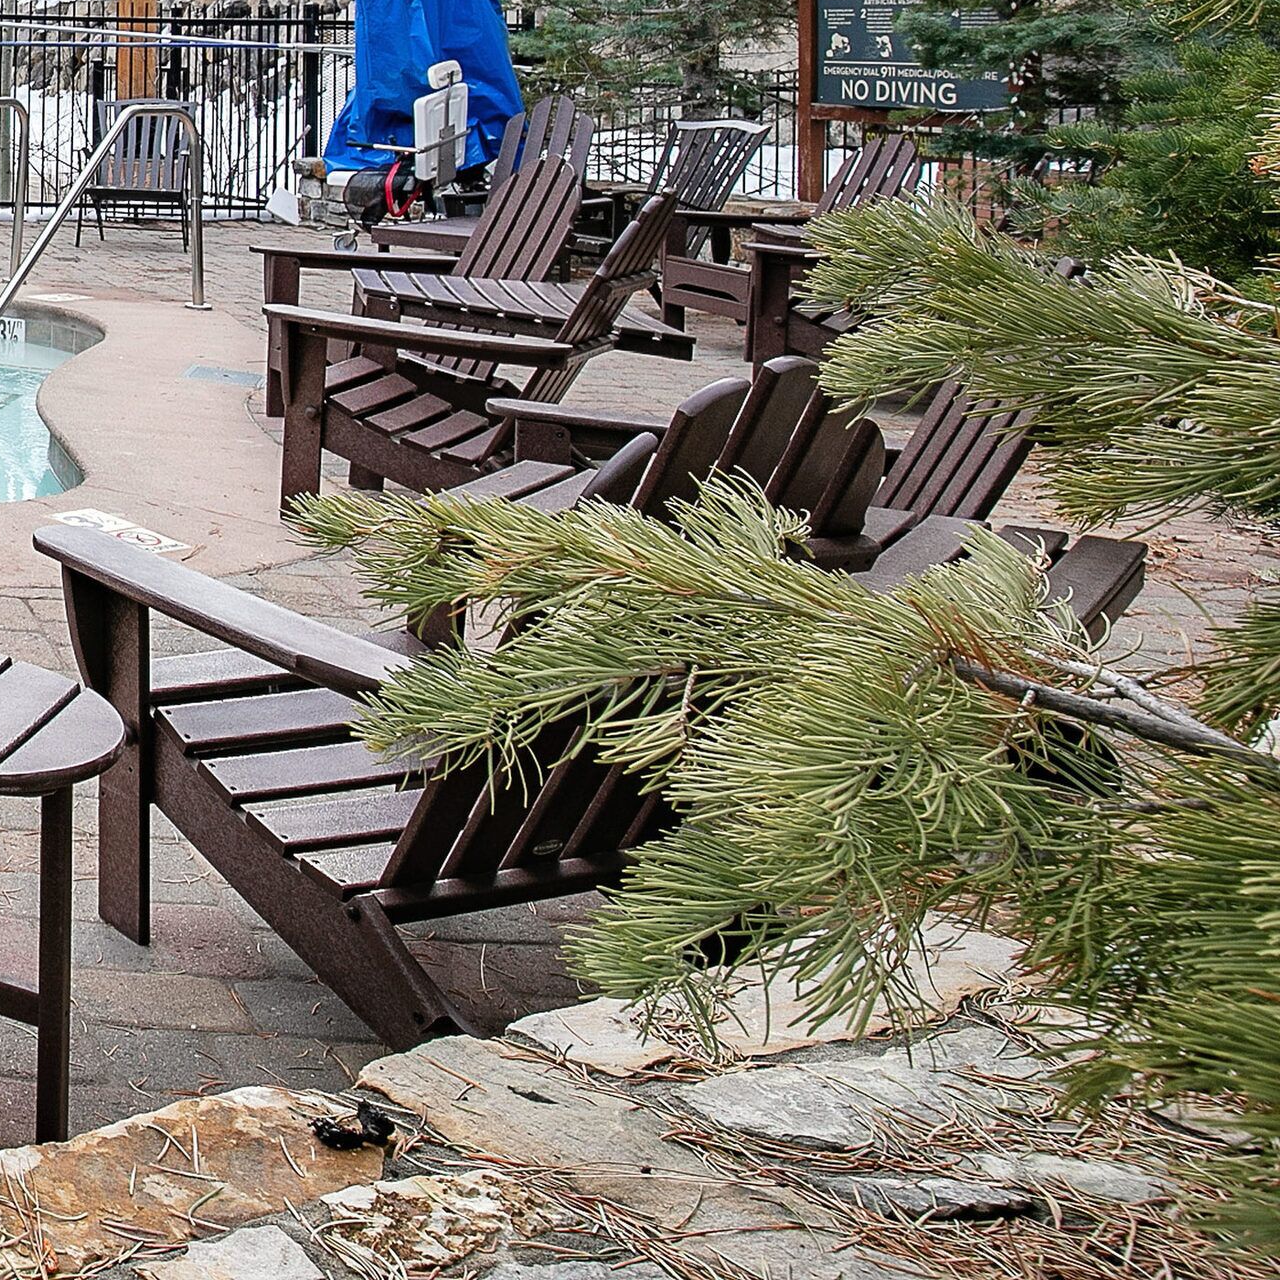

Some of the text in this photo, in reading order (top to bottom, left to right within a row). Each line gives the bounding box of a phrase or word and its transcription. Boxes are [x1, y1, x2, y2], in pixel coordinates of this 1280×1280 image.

[860, 8, 867, 19] 2
[823, 66, 862, 76] EMERGENCY
[863, 67, 880, 77] DIAL
[880, 66, 896, 78] 911
[841, 79, 957, 105] NO DIVING
